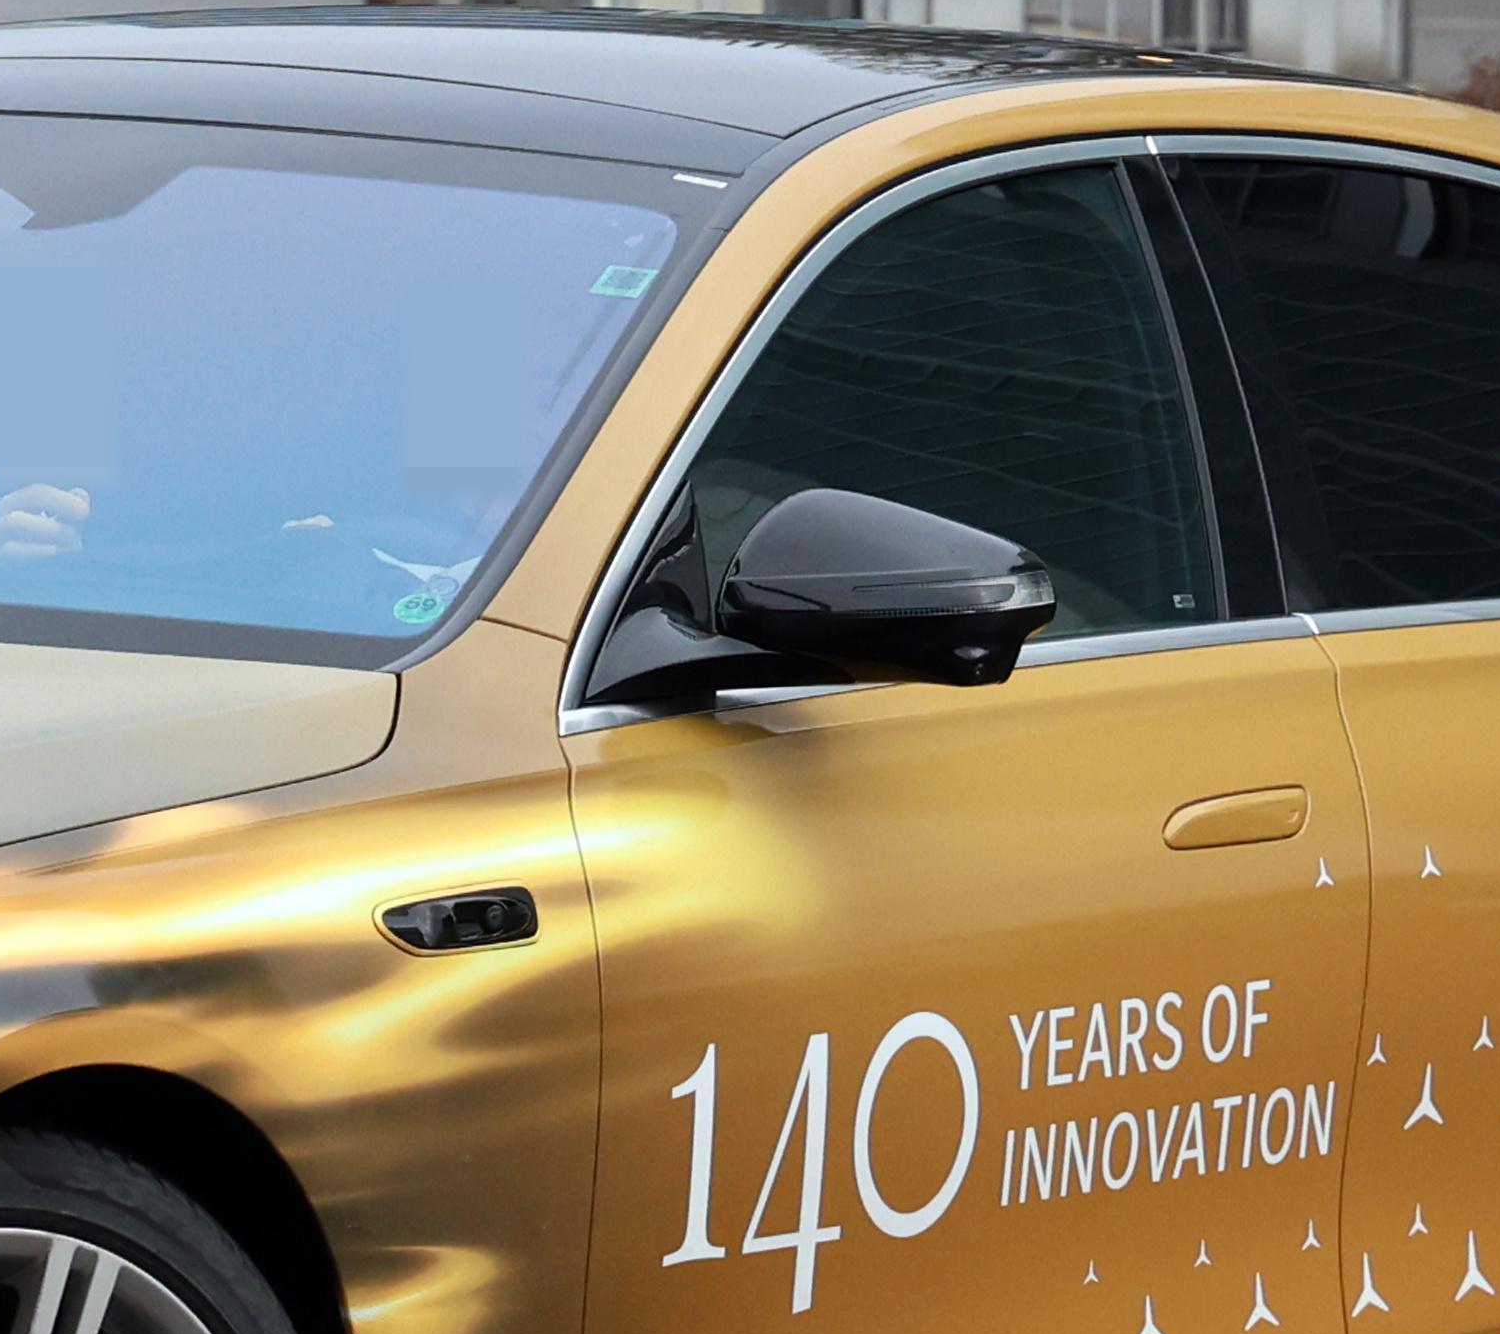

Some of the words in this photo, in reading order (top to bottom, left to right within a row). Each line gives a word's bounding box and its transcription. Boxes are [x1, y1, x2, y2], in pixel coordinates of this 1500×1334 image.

[661, 1010, 980, 1315] 140
[1008, 991, 1184, 1091] YEARS
[1201, 978, 1271, 1064] OF
[999, 1080, 1336, 1207] INNOVATION
